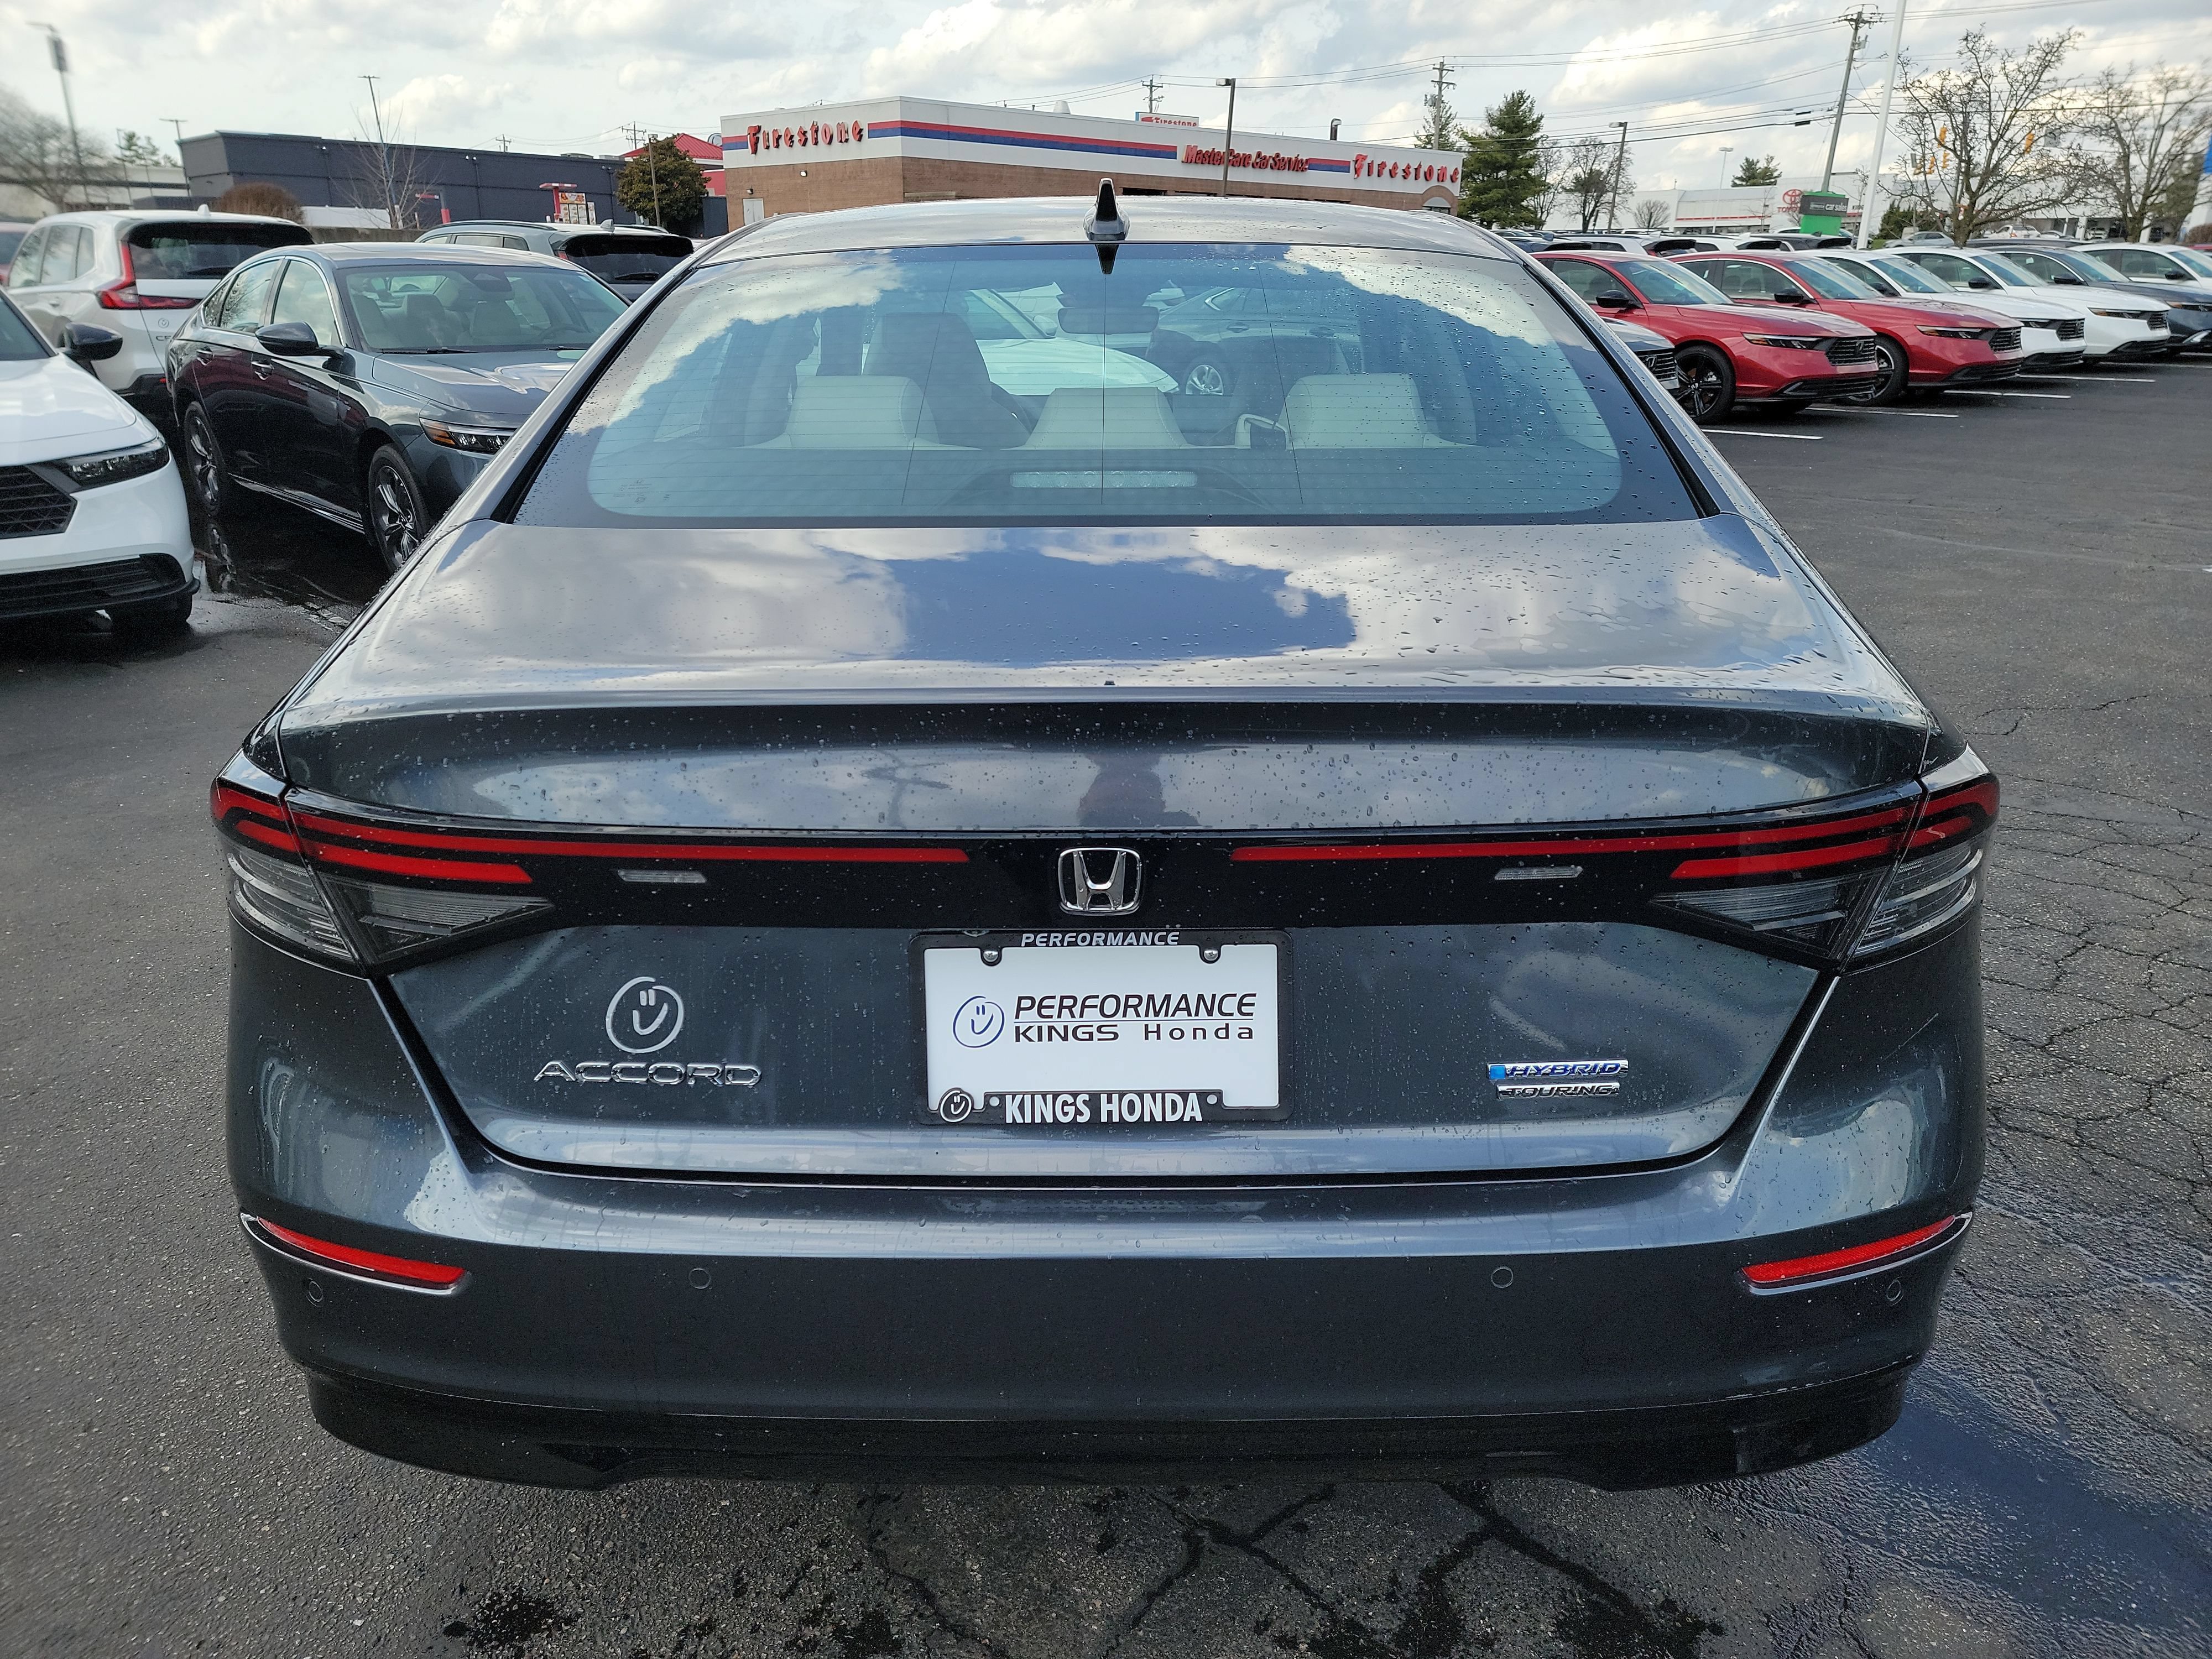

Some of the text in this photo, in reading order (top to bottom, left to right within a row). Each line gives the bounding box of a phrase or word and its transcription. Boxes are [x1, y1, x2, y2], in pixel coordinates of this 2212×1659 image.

[747, 120, 864, 155] Firestone
[1251, 151, 1272, 169] Car
[1270, 152, 1309, 172] Service
[1353, 153, 1460, 183] Firestone
[1021, 931, 1180, 947] PERFORMANCE
[1015, 992, 1257, 1019] PERFORMANCE
[1015, 1022, 1254, 1042] KINGS Honda
[534, 1060, 761, 1086] ACCORD
[1507, 1062, 1621, 1078] HYBRID
[1502, 1084, 1614, 1098] TOURING
[1005, 1092, 1203, 1124] KINGS HONDA
